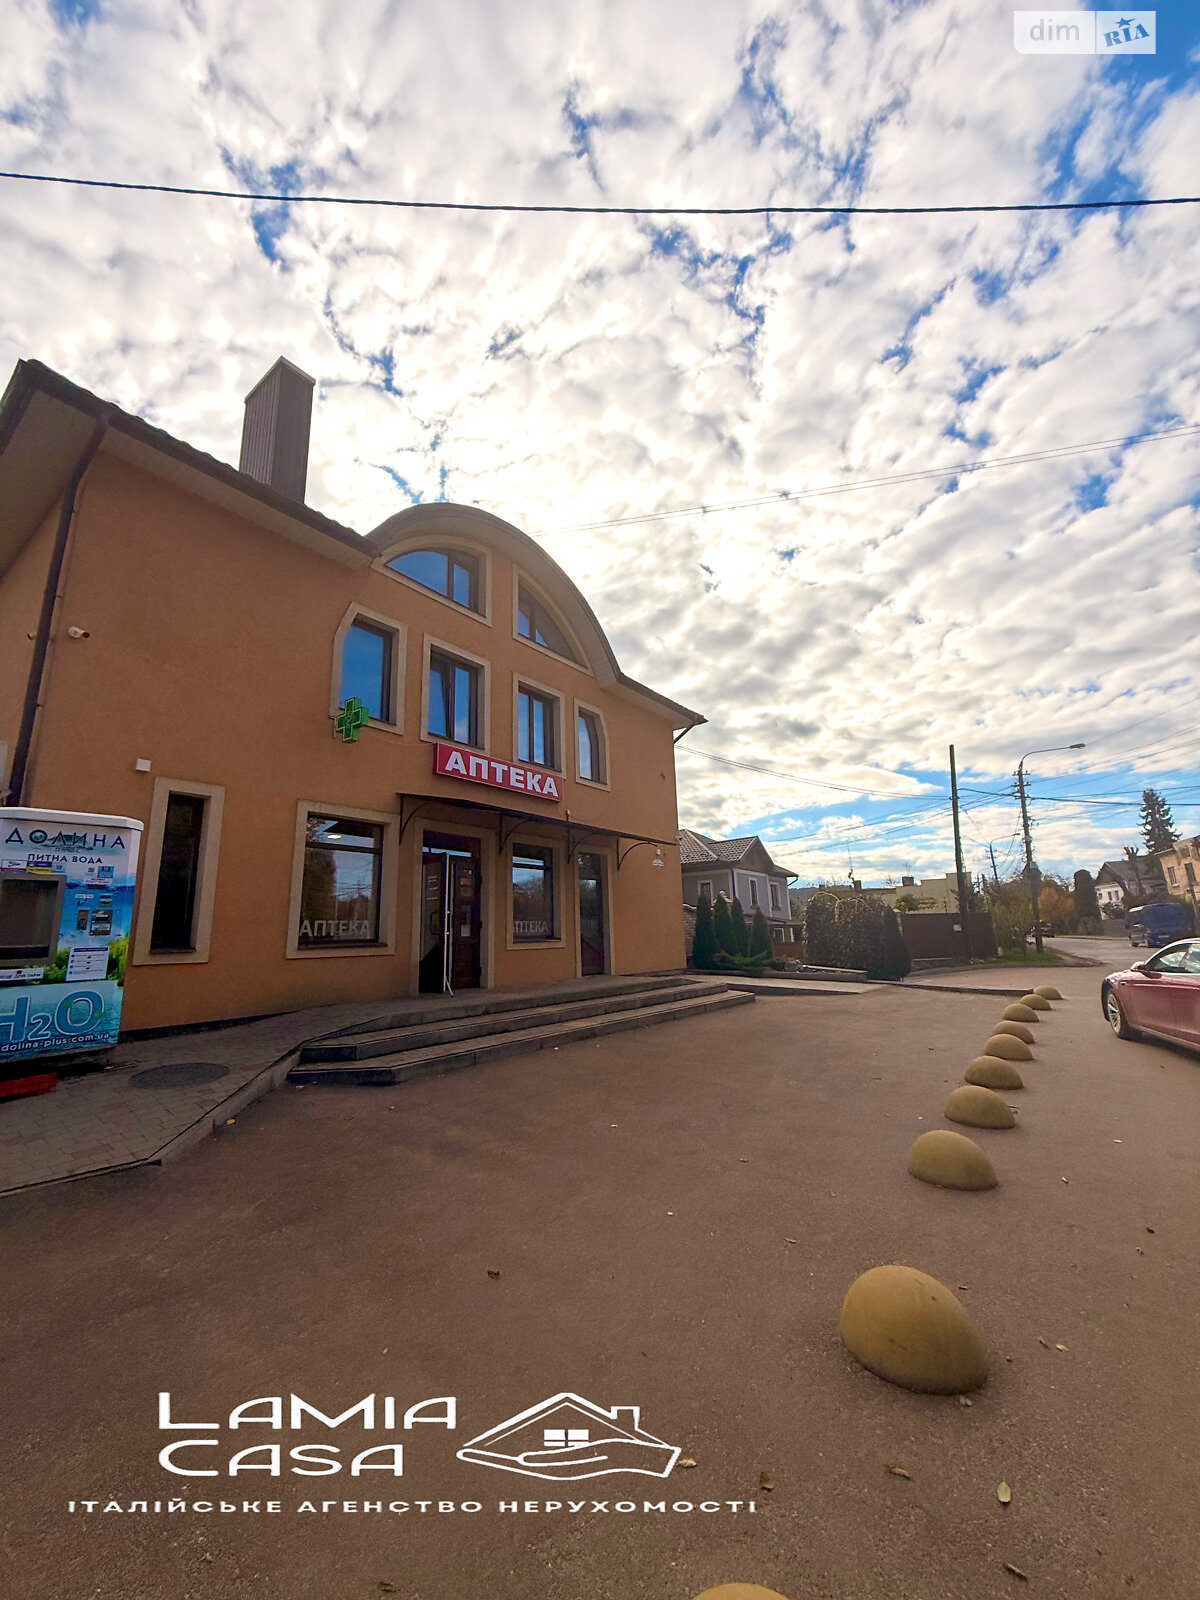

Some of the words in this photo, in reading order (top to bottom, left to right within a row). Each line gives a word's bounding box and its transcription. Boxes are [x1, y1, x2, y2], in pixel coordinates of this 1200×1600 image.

[445, 751, 559, 797] АПТЕКА
[5, 827, 125, 849] ДОЛИНА
[27, 854, 68, 863] ПИТНА
[72, 855, 103, 864] ВОДА
[299, 920, 371, 939] АПТЕКА
[1, 1034, 109, 1052] dolina-plus.com.ua
